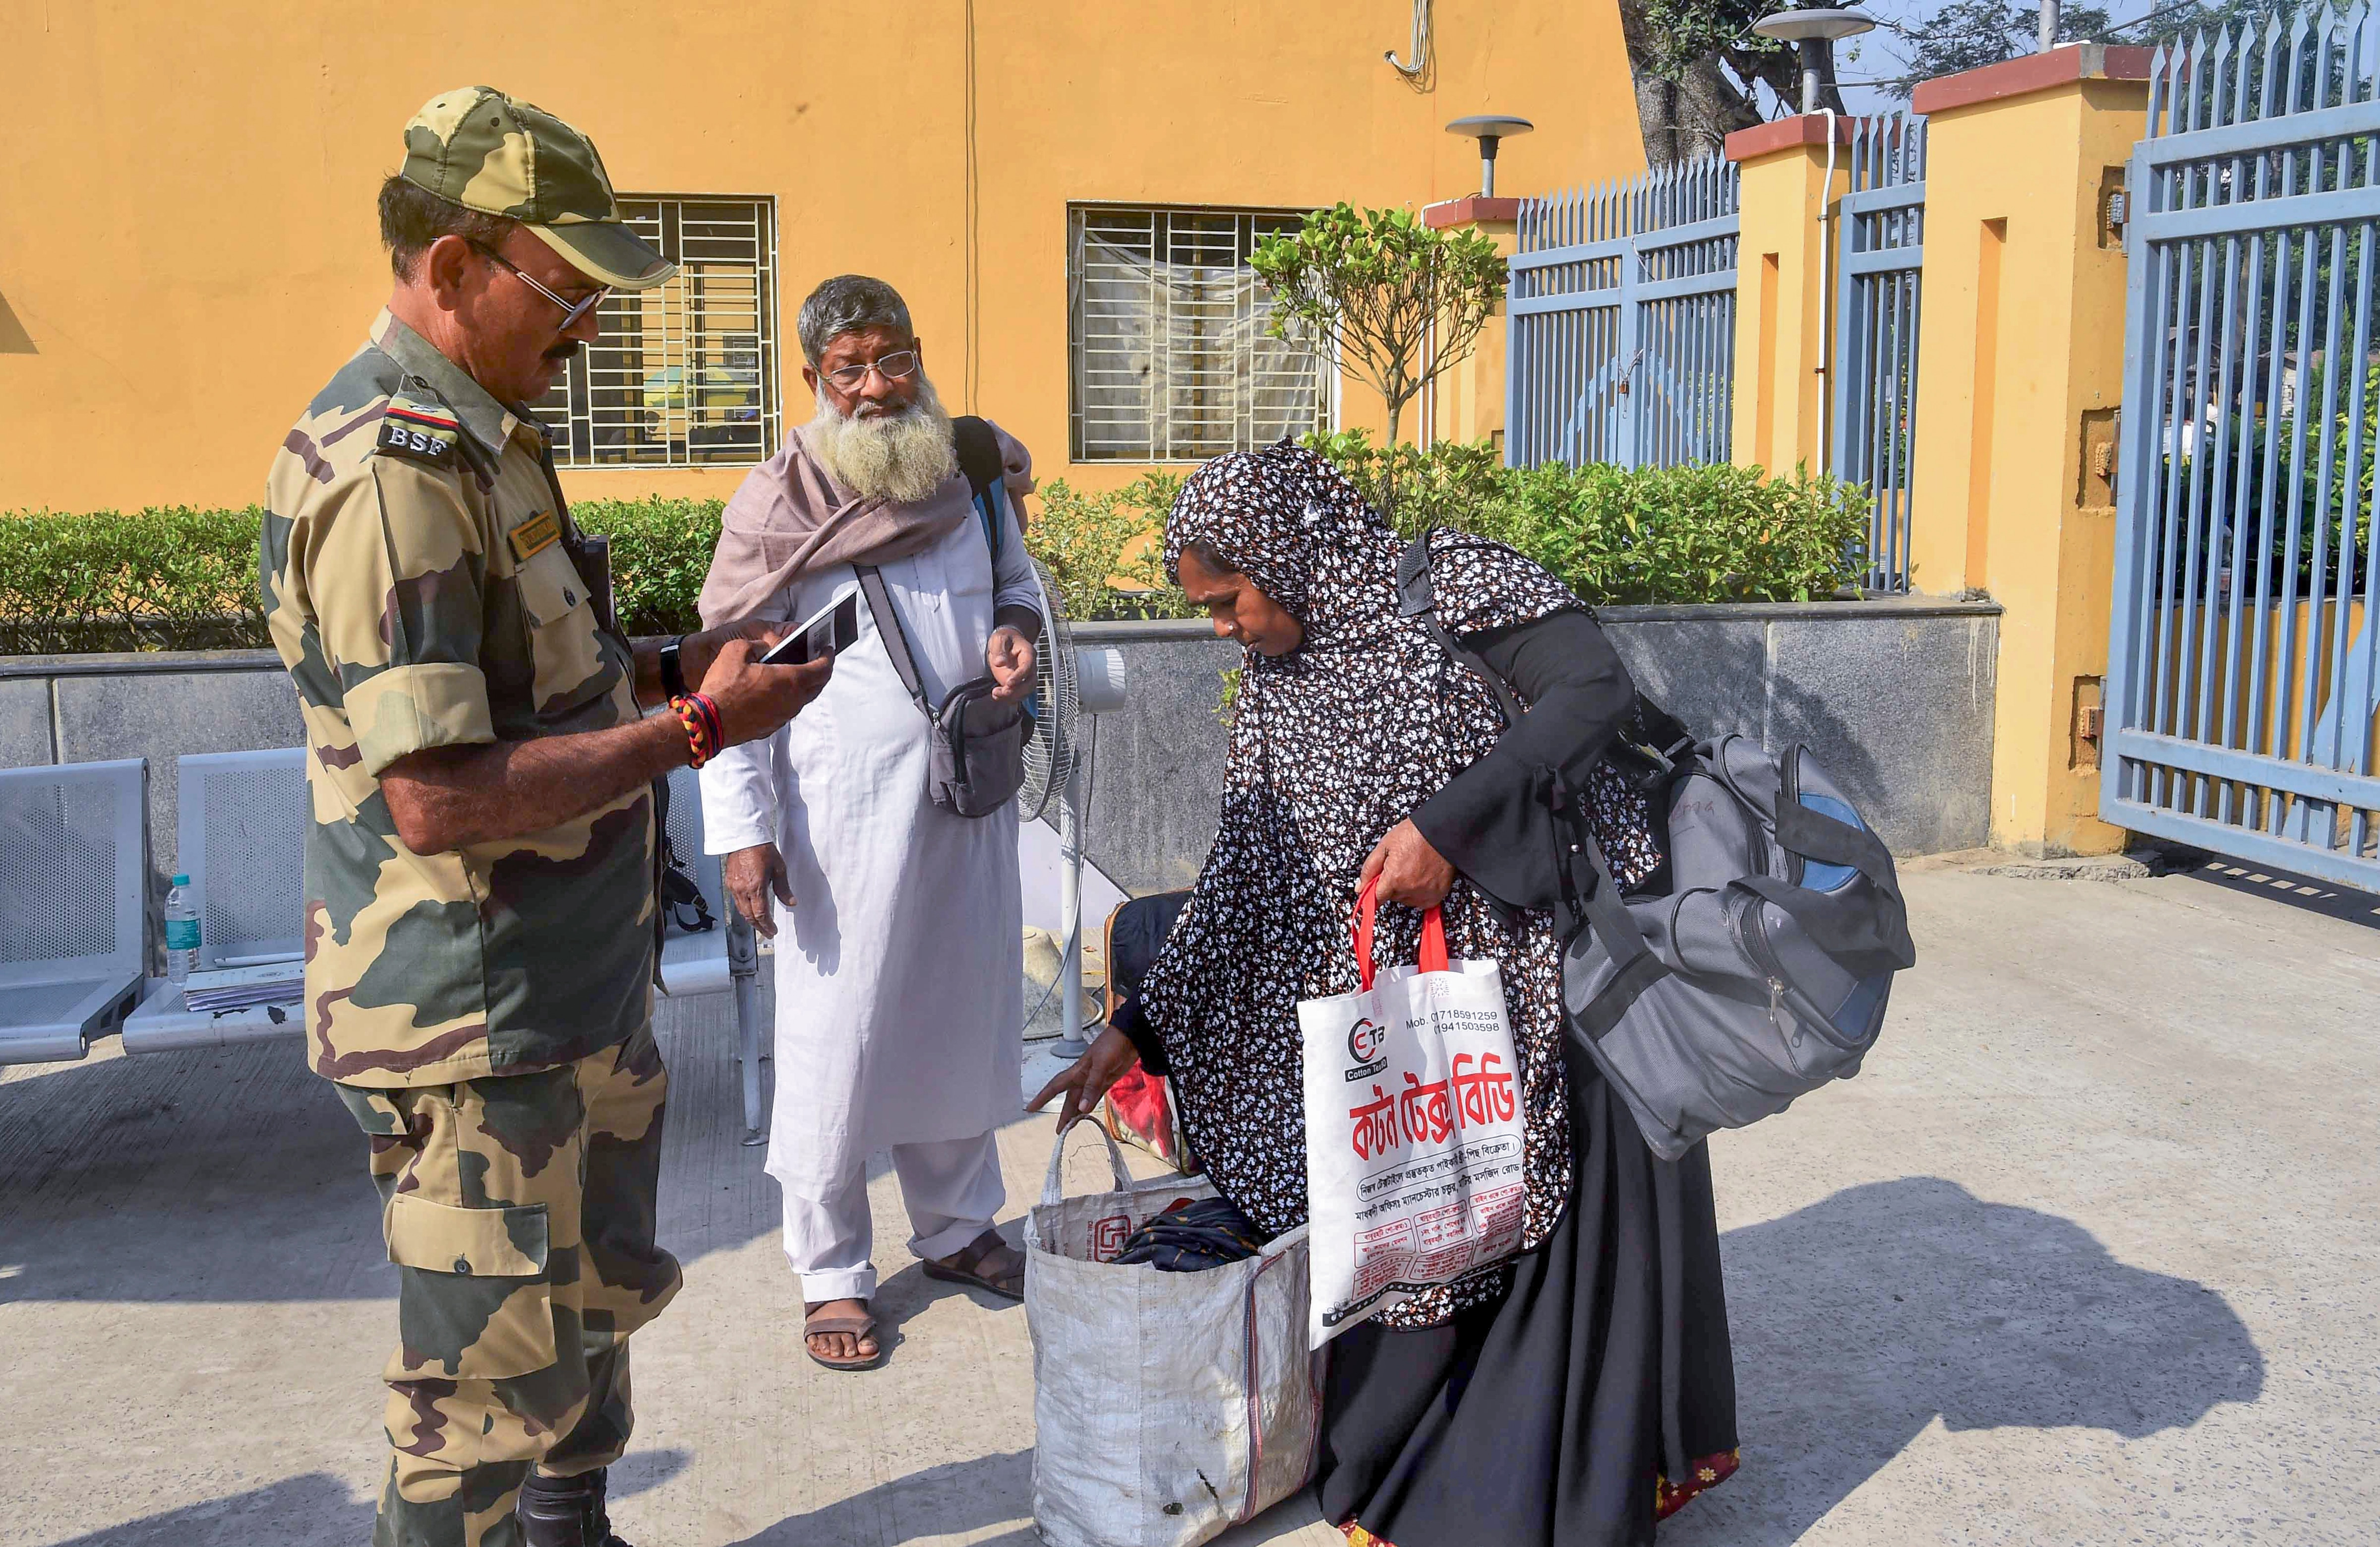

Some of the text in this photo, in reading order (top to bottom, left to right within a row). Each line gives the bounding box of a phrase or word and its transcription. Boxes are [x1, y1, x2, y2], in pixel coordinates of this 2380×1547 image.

[388, 427, 447, 455] BSF
[1406, 1010, 1497, 1030] Mob. 01718591259
[1347, 1068, 1371, 1080] Cotton
[1349, 1052, 1515, 1161] কটন টেক্স বিডি
[1481, 1142, 1510, 1157] বিক্রেতা
[1473, 1167, 1499, 1182] মসজিদ
[1502, 1164, 1521, 1175] রোড
